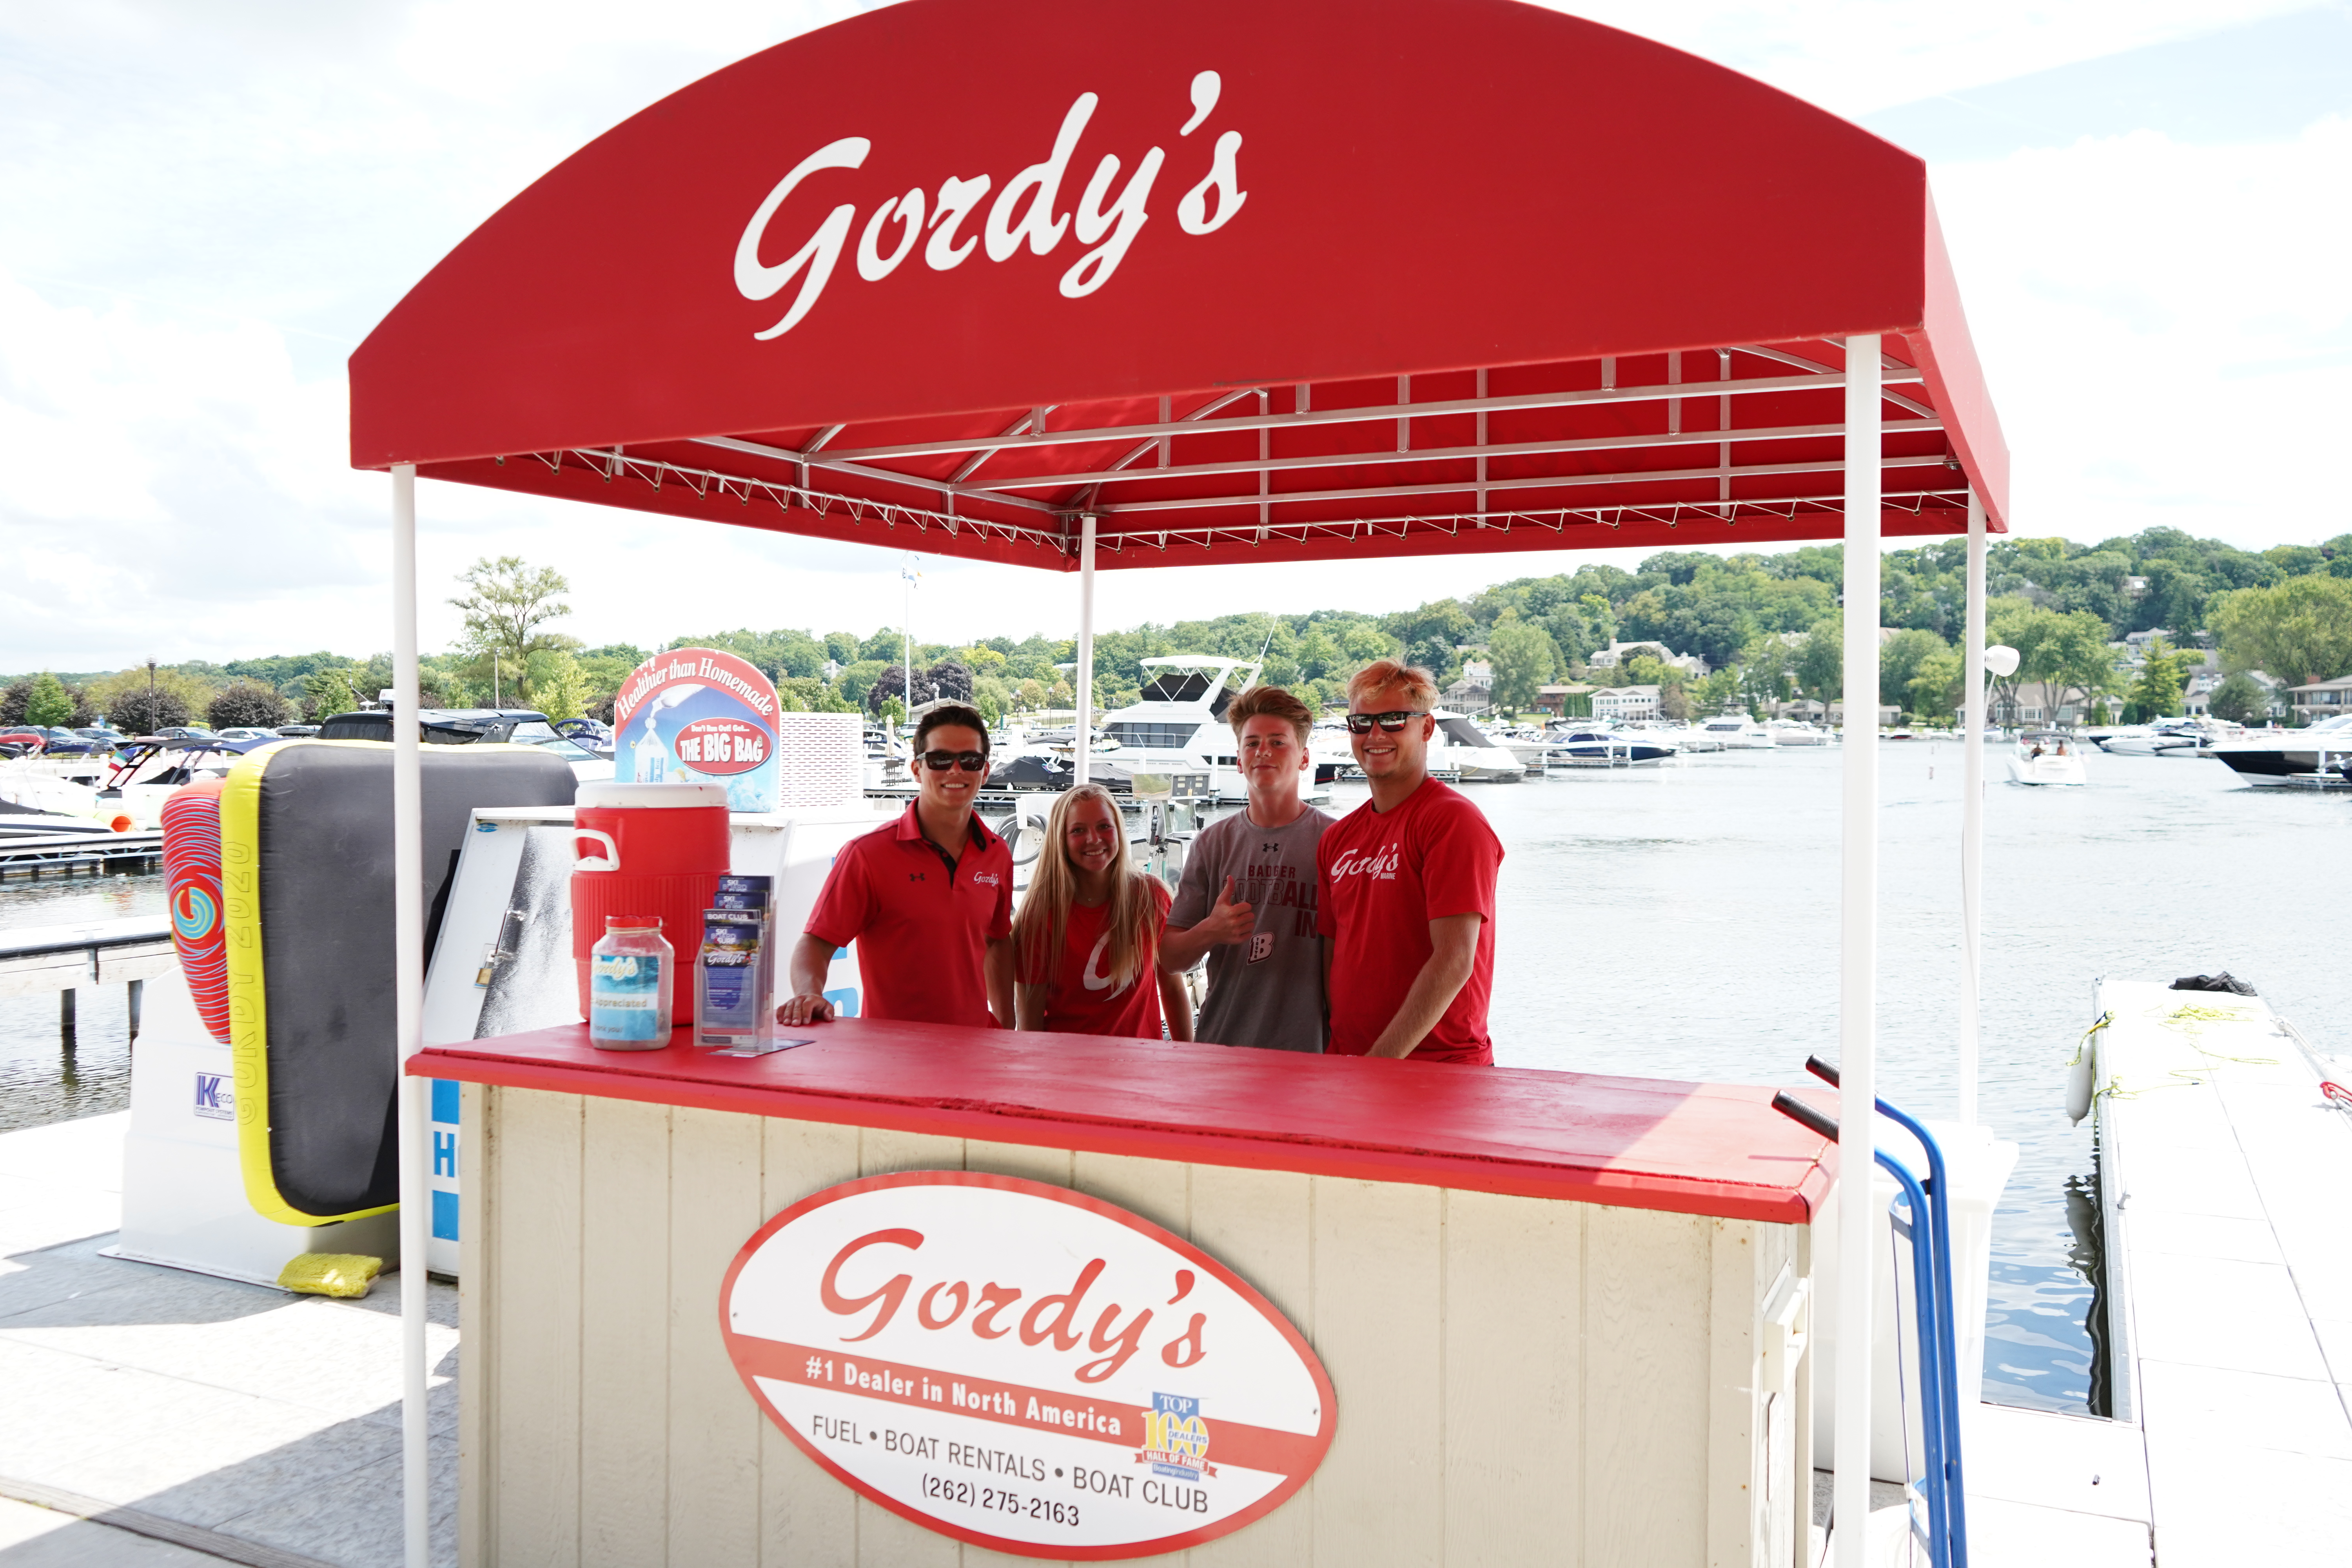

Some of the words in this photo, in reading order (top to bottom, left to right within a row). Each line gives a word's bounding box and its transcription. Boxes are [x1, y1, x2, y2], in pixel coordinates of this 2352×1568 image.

[733, 70, 1248, 341] Gordy's
[617, 666, 668, 721] Healthier
[669, 658, 696, 680] than
[698, 657, 773, 716] Homemade
[680, 737, 701, 762] THE
[704, 733, 731, 762] BIG
[734, 735, 764, 762] BAG
[974, 871, 999, 887] Gordy's
[1249, 865, 1296, 878] BADGER
[1331, 842, 1399, 884] Gordy's
[1294, 910, 1318, 939] IN
[707, 953, 742, 966] Gordy's
[820, 1228, 1207, 1384] Gordy's
[806, 1356, 834, 1382] #1
[844, 1362, 914, 1397] Dealer
[922, 1376, 942, 1403] in
[952, 1382, 1017, 1417] North
[1025, 1396, 1122, 1437] America
[1159, 1394, 1193, 1414] TOP
[1141, 1409, 1209, 1459] 100
[1168, 1430, 1208, 1444] DEALERS
[813, 1415, 863, 1445] FUEL
[885, 1429, 940, 1461] BOAT
[949, 1441, 1046, 1482] RENTALS
[1073, 1466, 1135, 1499] BOAT
[1142, 1479, 1210, 1515] CLUB
[1146, 1450, 1168, 1463] HALL
[1169, 1453, 1180, 1465] OF
[1181, 1455, 1205, 1471] FAME
[922, 1472, 976, 1508] (262)
[982, 1488, 1080, 1527] 275-2163
